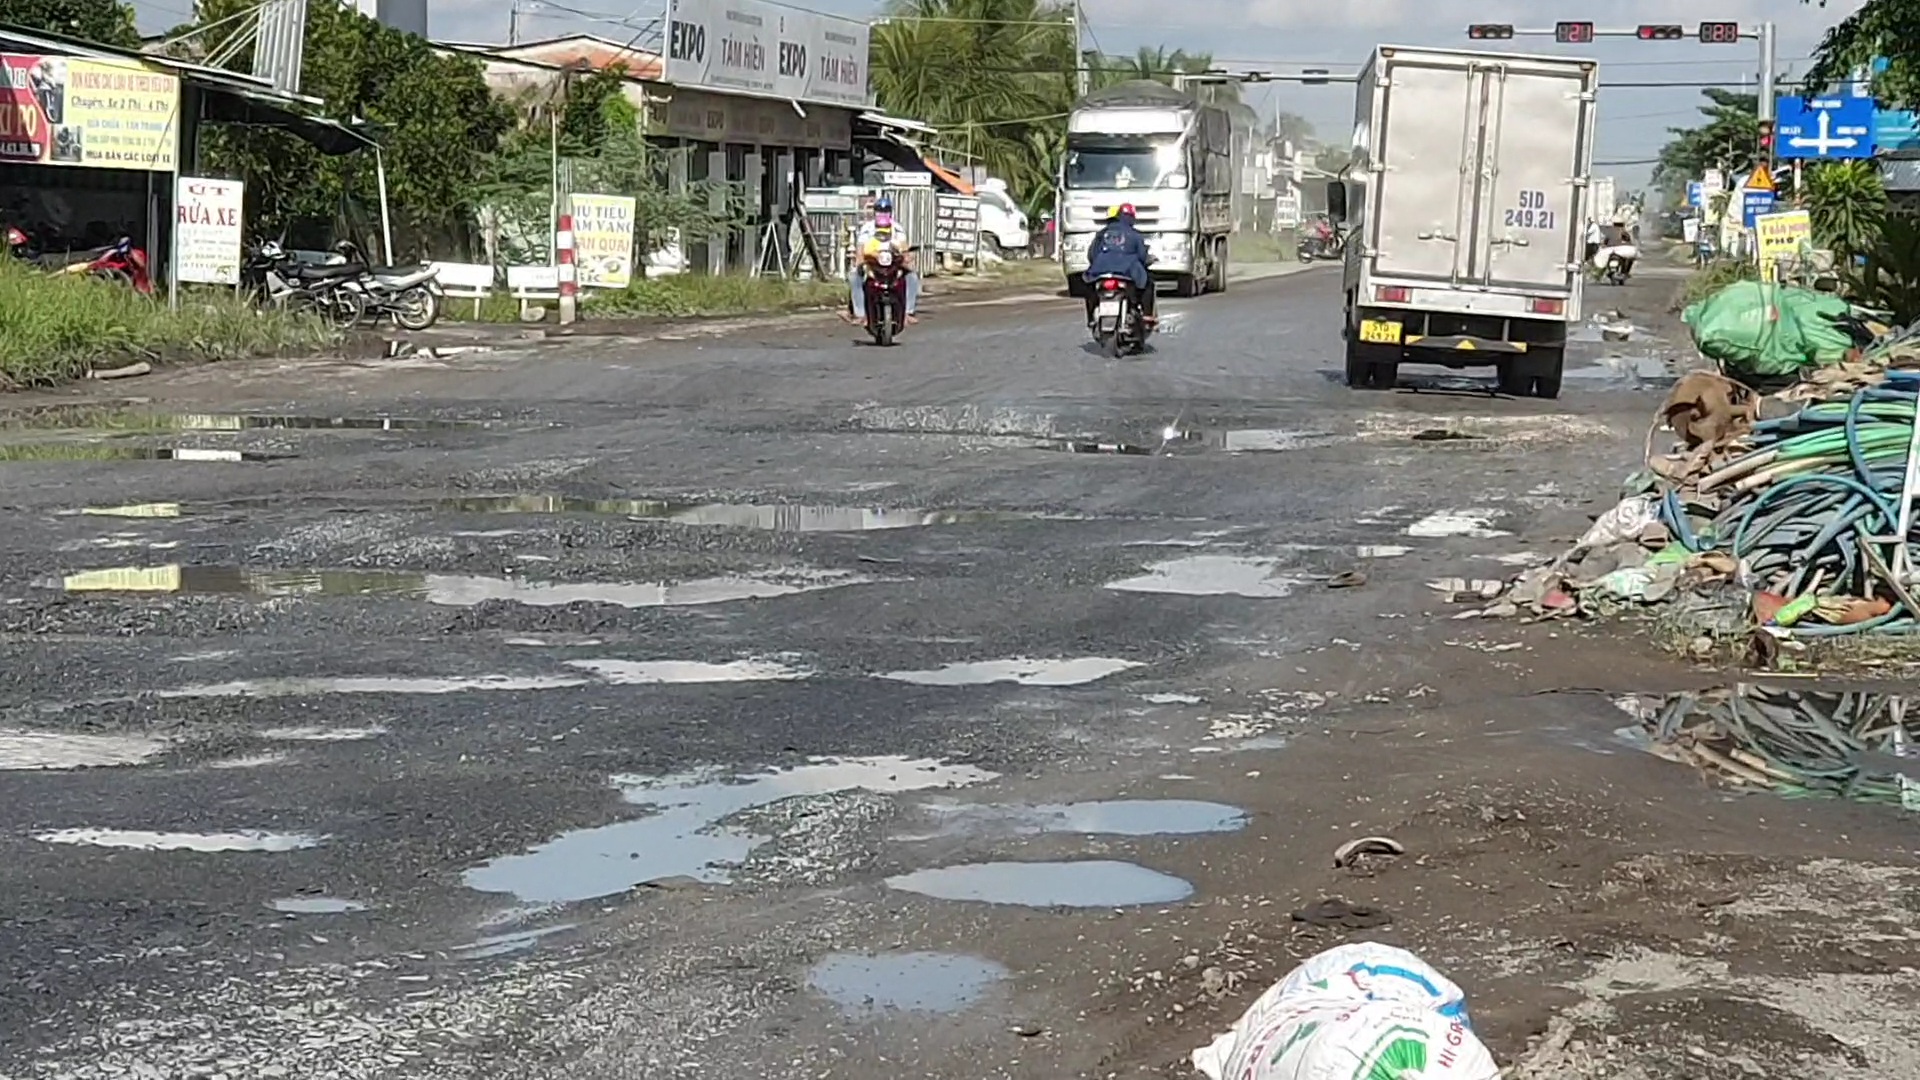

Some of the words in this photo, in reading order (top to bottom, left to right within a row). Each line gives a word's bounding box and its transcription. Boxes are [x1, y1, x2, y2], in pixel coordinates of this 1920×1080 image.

[670, 21, 705, 63] EXPO
[722, 32, 742, 67] TÁM
[779, 42, 806, 79] EXPO
[821, 51, 839, 83] TÁM
[178, 198, 211, 226] RỬA
[217, 208, 237, 227] XE
[1519, 190, 1544, 209] 51D
[1505, 209, 1554, 229] 249.21
